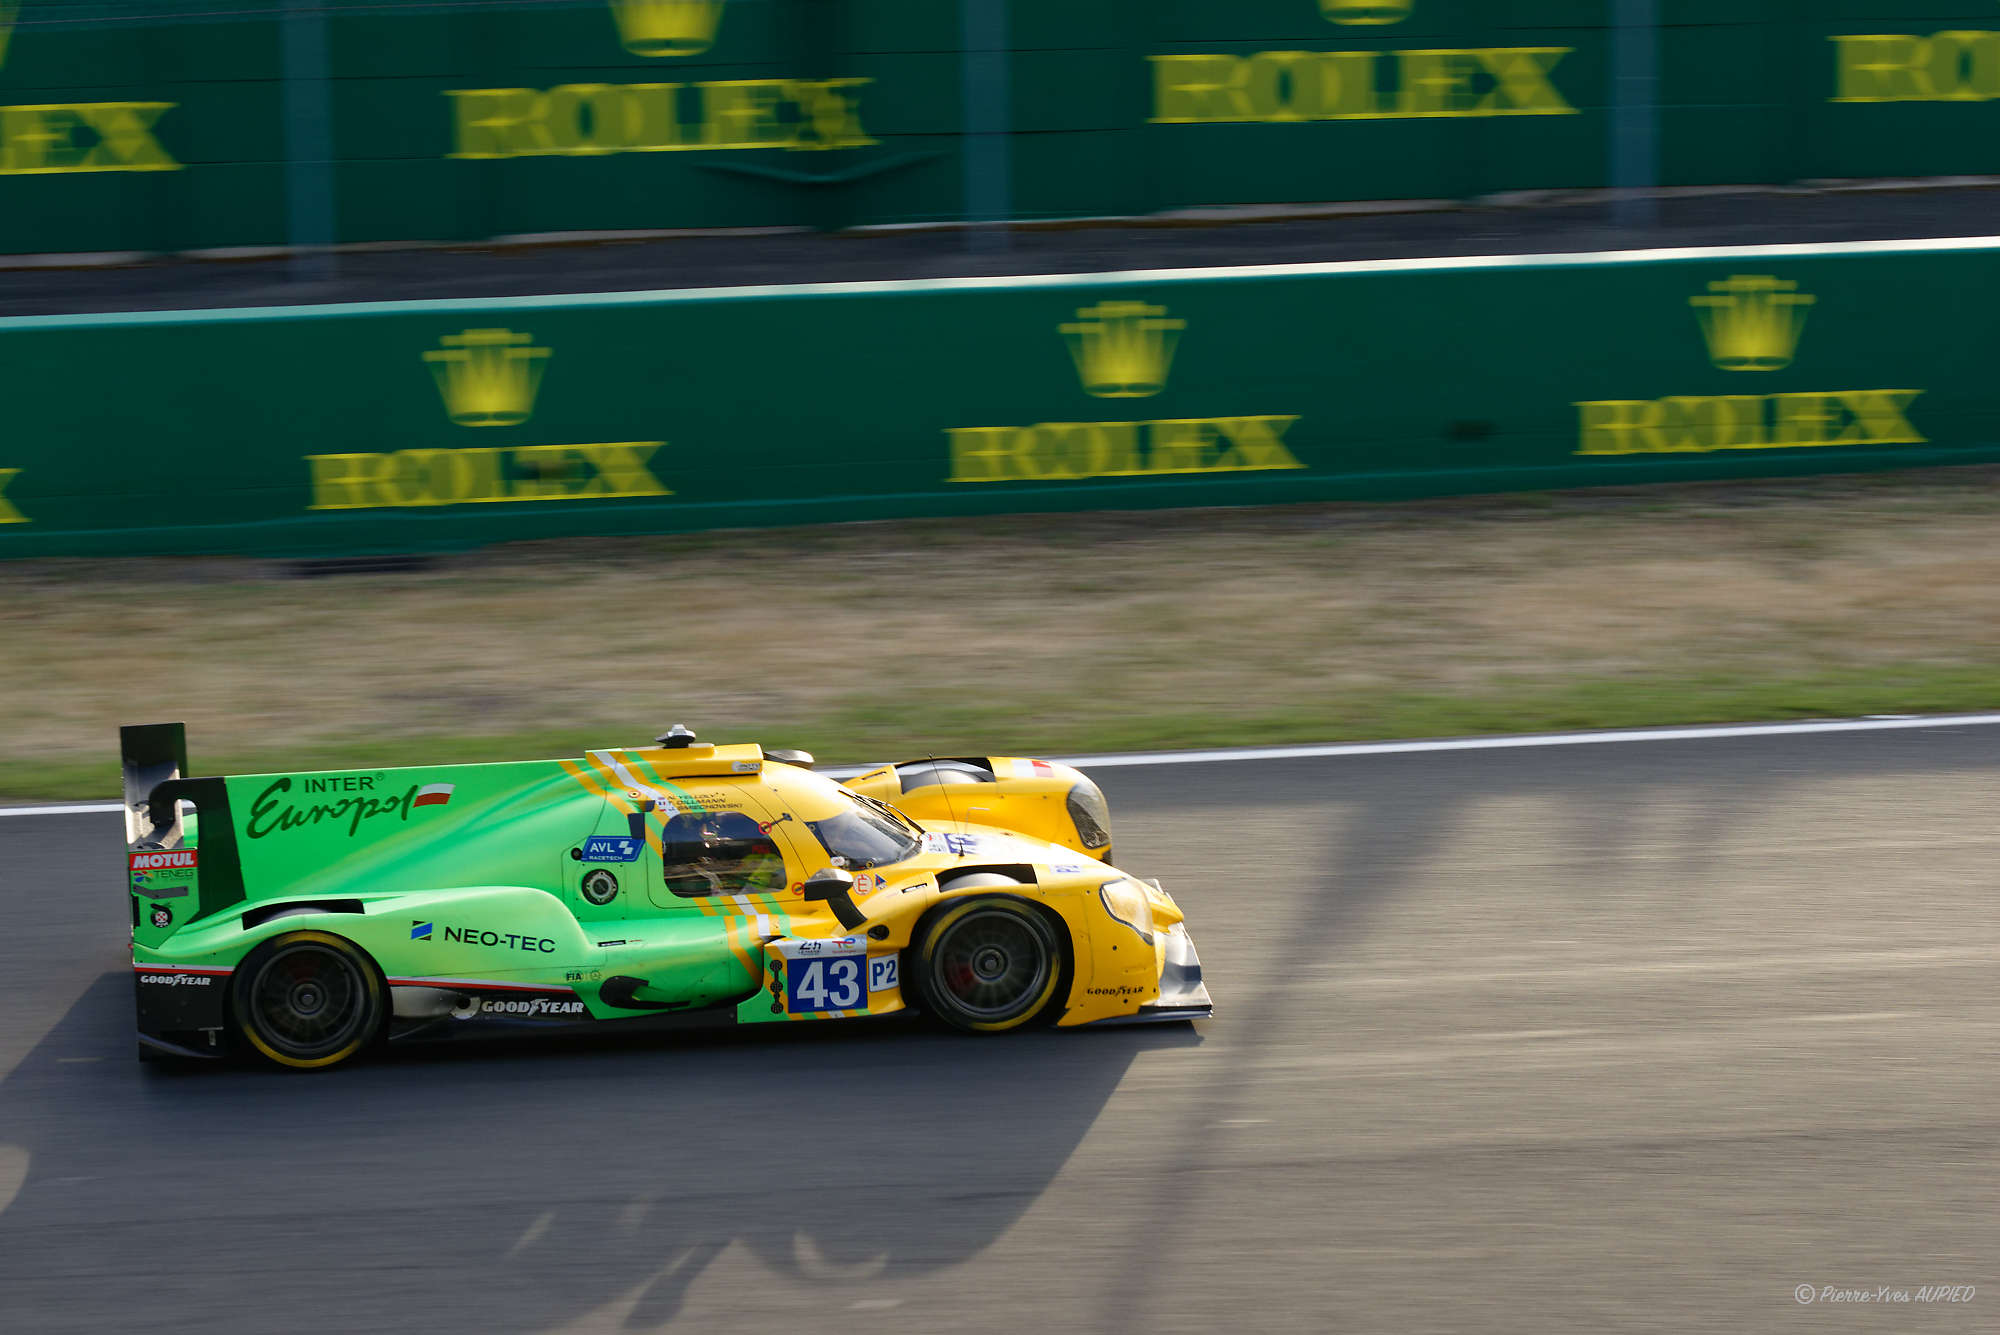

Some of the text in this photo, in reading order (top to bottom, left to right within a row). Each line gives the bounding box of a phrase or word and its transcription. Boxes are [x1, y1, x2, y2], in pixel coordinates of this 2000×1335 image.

[1147, 46, 1580, 124] ROLEX
[444, 77, 882, 160] ROLEX
[1573, 389, 1928, 456] ROLEX
[943, 414, 1309, 483] ROLEX
[305, 776, 375, 793] INTER
[247, 777, 418, 839] Europol
[133, 852, 194, 869] MOTUL
[590, 842, 615, 853] AVL
[444, 926, 556, 953] NEO-TEC
[140, 974, 211, 987] GOODYEAR
[566, 973, 582, 981] FIA
[796, 959, 860, 1008] 43
[872, 959, 897, 987] P2
[481, 998, 584, 1017] GOODYEAR
